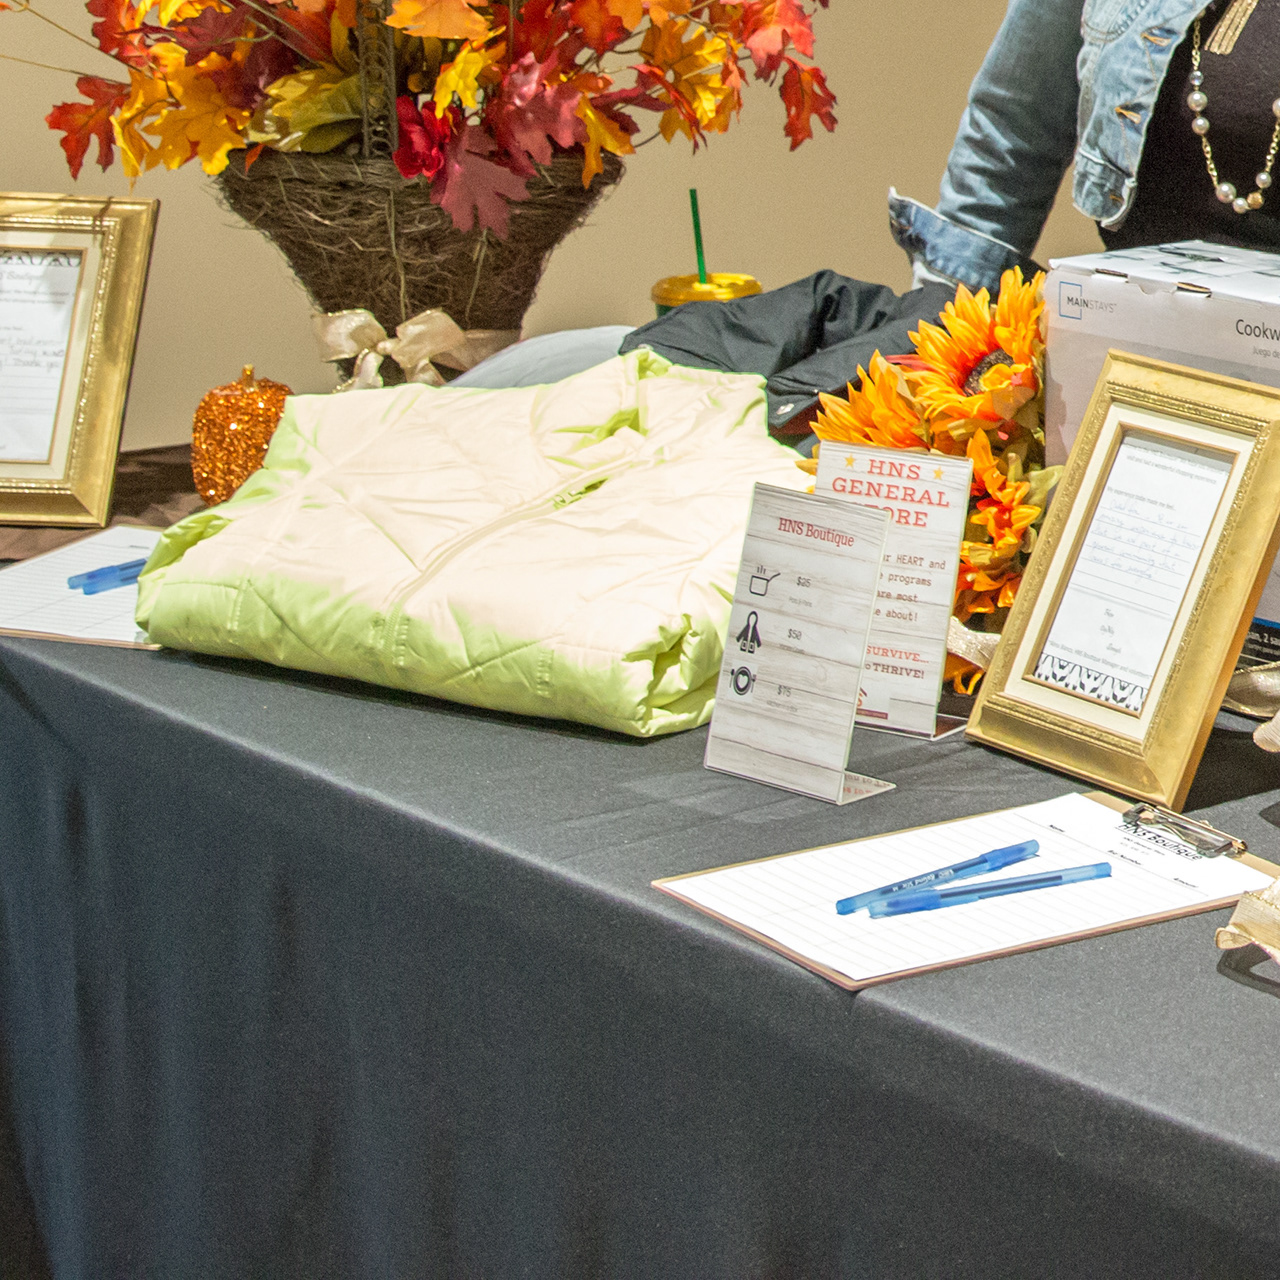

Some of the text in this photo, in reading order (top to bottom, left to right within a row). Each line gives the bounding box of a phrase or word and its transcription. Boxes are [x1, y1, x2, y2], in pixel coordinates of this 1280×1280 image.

[1067, 296, 1114, 313] MAINSTAYS
[867, 459, 921, 480] HNS
[832, 477, 950, 507] GENERAL
[778, 517, 854, 547] HNS Boutique
[897, 554, 946, 570] HEART and
[888, 574, 932, 587] programs
[897, 593, 919, 603] most
[886, 609, 918, 622] about!
[787, 628, 802, 640] $50
[1264, 633, 1269, 643] 2
[872, 663, 925, 680] THRIVE!
[1148, 833, 1202, 861] Boutique
